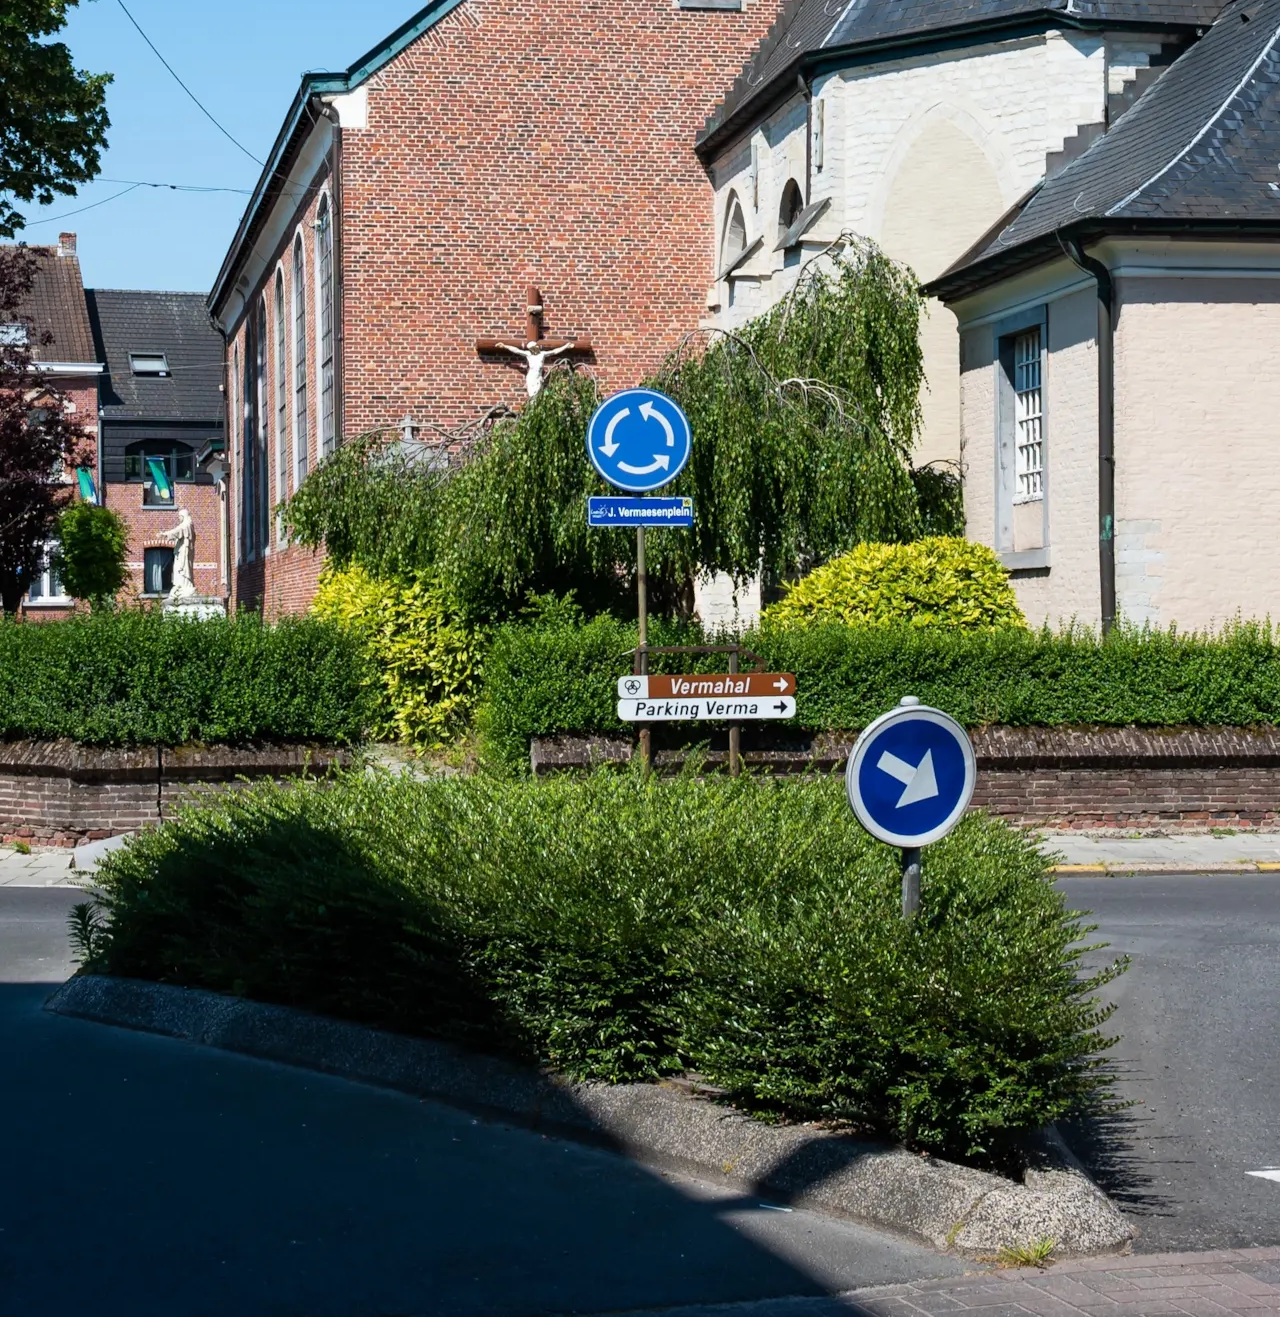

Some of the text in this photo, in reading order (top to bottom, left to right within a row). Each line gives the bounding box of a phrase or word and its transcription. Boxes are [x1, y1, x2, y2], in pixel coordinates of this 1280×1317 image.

[608, 507, 617, 518] J.
[618, 506, 690, 519] Vermaesenplein
[670, 677, 751, 695] Vermahal
[635, 701, 758, 719] Parking Verma
